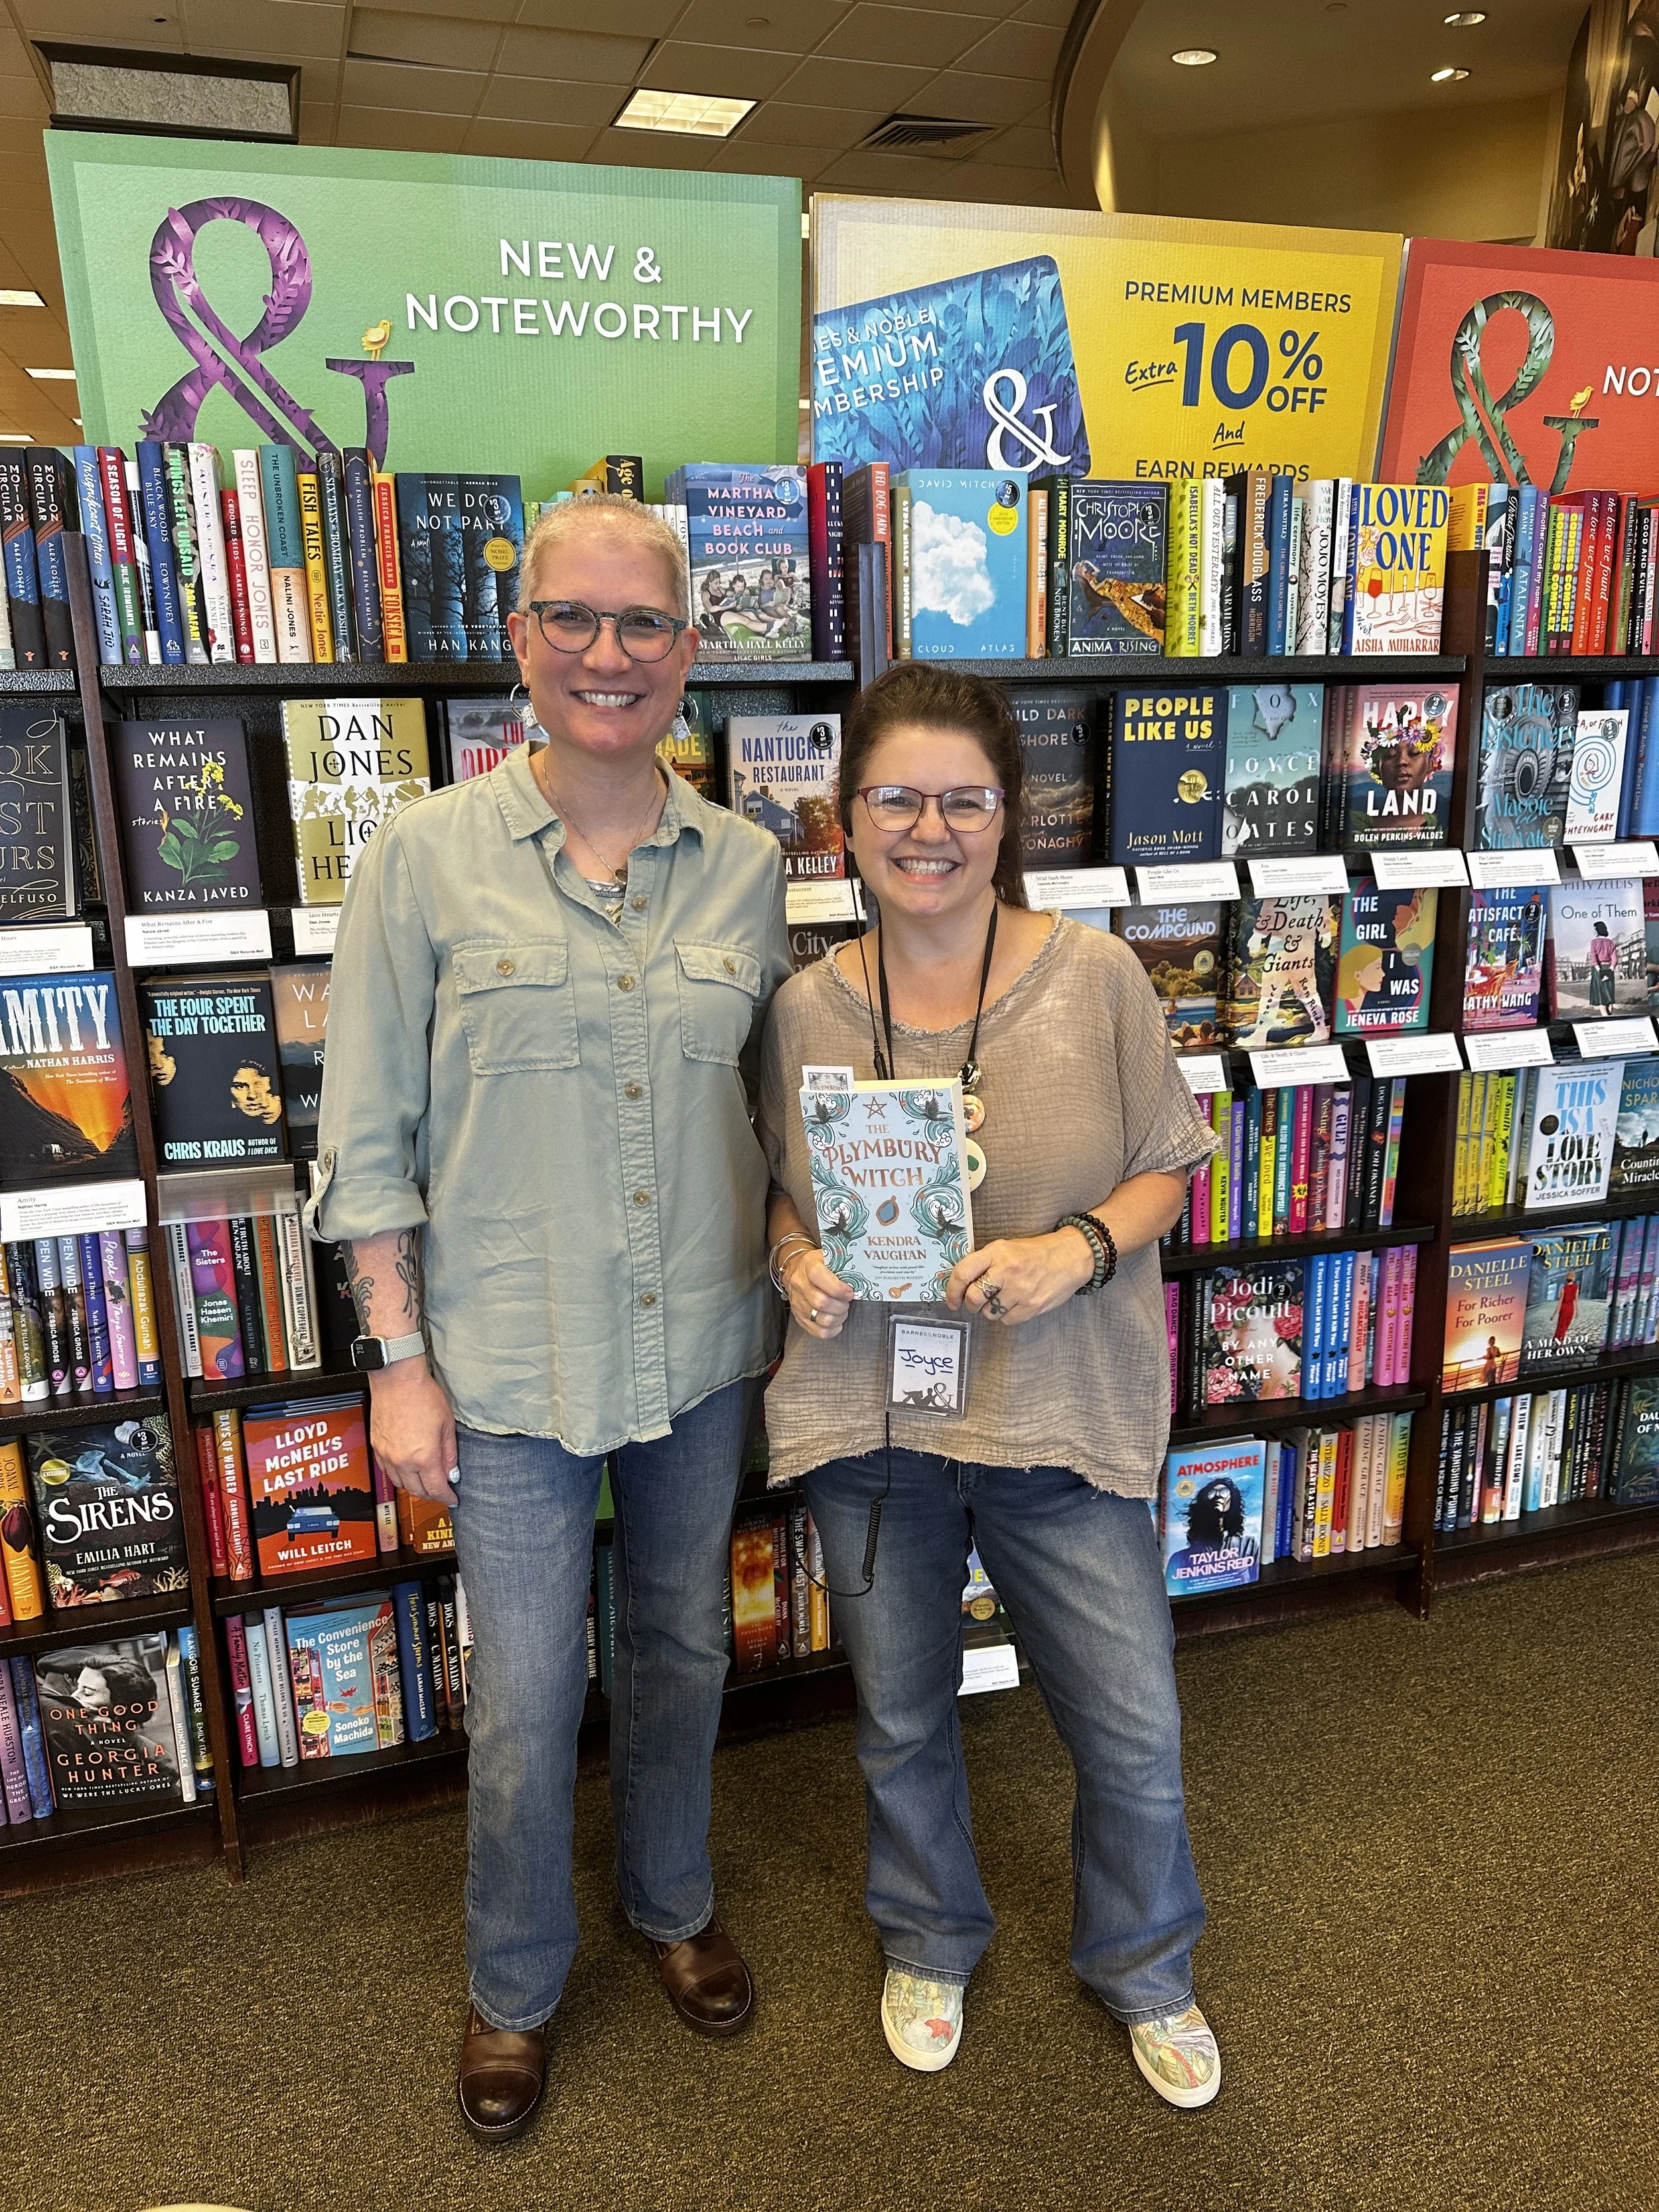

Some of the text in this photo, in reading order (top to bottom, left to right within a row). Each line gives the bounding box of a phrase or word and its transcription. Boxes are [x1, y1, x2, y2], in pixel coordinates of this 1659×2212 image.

[499, 238, 663, 284] NEW &
[1125, 281, 1352, 314] PREMIUM MEMBERS
[404, 292, 755, 344] NOTEWORTHY
[847, 309, 929, 344] & NOBLE
[1125, 360, 1178, 386] Extra
[1267, 387, 1329, 413] OFF
[1212, 421, 1245, 443] And
[739, 473, 754, 483] The
[1135, 459, 1194, 480] EARN
[145, 482, 158, 529] BLUE SKY
[153, 467, 169, 543] BLACK WOODS
[428, 493, 455, 508] WE
[1362, 486, 1447, 528] LOVED
[707, 506, 786, 518] VINEYARD
[302, 482, 322, 561] FISH TALES
[416, 516, 452, 530] NOT
[713, 525, 784, 536] BEACH and
[241, 460, 270, 629] SLEEP HONOR JONES
[1076, 517, 1161, 558] MOORE
[1250, 478, 1266, 602] FREDERICK DOUGLASS
[705, 543, 792, 555] BOOK CLUB
[1376, 532, 1432, 571] ONE
[1315, 530, 1331, 621] JOJO MOYES
[1514, 569, 1529, 639] ATALANTA
[429, 639, 512, 651] HAN KANG
[775, 640, 806, 649] KELLY
[1072, 640, 1157, 653] ANIMA RISING
[1354, 636, 1439, 652] AISHA MUHARRAR
[1125, 697, 1214, 717] PEOPLE
[318, 714, 394, 742] DAN
[776, 721, 798, 733] the
[1124, 720, 1212, 741] LIKE US
[149, 731, 205, 746] WHAT
[133, 751, 227, 769] REMAINS
[309, 749, 413, 784] JONES
[1228, 756, 1317, 774] JOYCE
[153, 774, 213, 791] AFTER
[753, 765, 825, 783] RESTAURANT
[153, 795, 217, 812] A FIRE
[1226, 788, 1315, 807] CAROL
[1366, 789, 1437, 817] LAND
[132, 817, 163, 826] stories
[1226, 821, 1315, 839] OATES
[1127, 830, 1204, 849] Jason Mott
[1354, 831, 1444, 842] DOLEN PERKINS-VALDEZ
[798, 855, 837, 873] KELLEY
[143, 886, 250, 903] KANZA JAVED
[1352, 897, 1378, 913] THE
[1561, 904, 1637, 919] One of Them
[1157, 908, 1187, 924] THE
[1125, 921, 1216, 940] COMPOUND
[1356, 923, 1387, 940] GIRL
[1488, 923, 1517, 942] CAFÉ
[1262, 954, 1315, 974] Giants
[1390, 978, 1419, 995] WAS
[154, 996, 255, 1017] THE FOUR SPENT
[0, 984, 111, 1056] MITY
[150, 1014, 265, 1035] THE DAY TOGETHER
[1346, 1010, 1419, 1027] JENEVA ROSE
[27, 1054, 115, 1069] NATHAN HARRIS
[865, 1124, 890, 1134] THE
[164, 1139, 246, 1161] CHRIS KRAUS
[822, 1139, 943, 1170] PLYMBURY
[841, 1167, 924, 1187] WITCH
[1534, 1159, 1606, 1191] STORY
[1536, 1186, 1600, 1201] JESSICA SOFFER
[867, 1236, 922, 1247] KENDRA
[195, 1256, 226, 1266] Sisters
[863, 1249, 927, 1260] VAUGHAN
[1450, 1256, 1527, 1279] DANIELLE
[1229, 1276, 1273, 1297] Jodi
[1464, 1273, 1512, 1291] STEEL
[200, 1306, 232, 1315] Hassen
[1210, 1301, 1293, 1324] Picoult
[1457, 1295, 1515, 1312] For Richer
[200, 1314, 234, 1323] Khemiri
[1455, 1311, 1513, 1329] For Poorer
[1222, 1338, 1278, 1352] BY ANY
[898, 1349, 954, 1375] Joyce
[1224, 1355, 1274, 1366] OTHER
[1227, 1370, 1271, 1382] NAME
[275, 1421, 328, 1449] LLOYD
[265, 1436, 343, 1473] McNEIL'S
[263, 1453, 349, 1493] LAST RIDE
[1177, 1454, 1260, 1477] ATMOSPHERE
[94, 1486, 118, 1501] THE
[46, 1492, 174, 1544] SIRENS
[76, 1542, 155, 1565] EMILIA HART
[277, 1540, 352, 1561] WILL LEITCH
[1189, 1547, 1240, 1565] TAYLOR
[1171, 1556, 1254, 1580] JENKINS REID
[295, 1637, 316, 1649] The
[318, 1614, 389, 1643] Convenience
[326, 1638, 360, 1656] Store
[326, 1652, 363, 1670] by the
[335, 1669, 356, 1682] Sea
[50, 1700, 159, 1720] ONE GOOD
[75, 1720, 137, 1735] THING
[334, 1716, 370, 1733] Sonoko
[333, 1727, 374, 1745] Machida
[56, 1744, 166, 1766] GEORGIA
[68, 1763, 160, 1783] HUNTER
